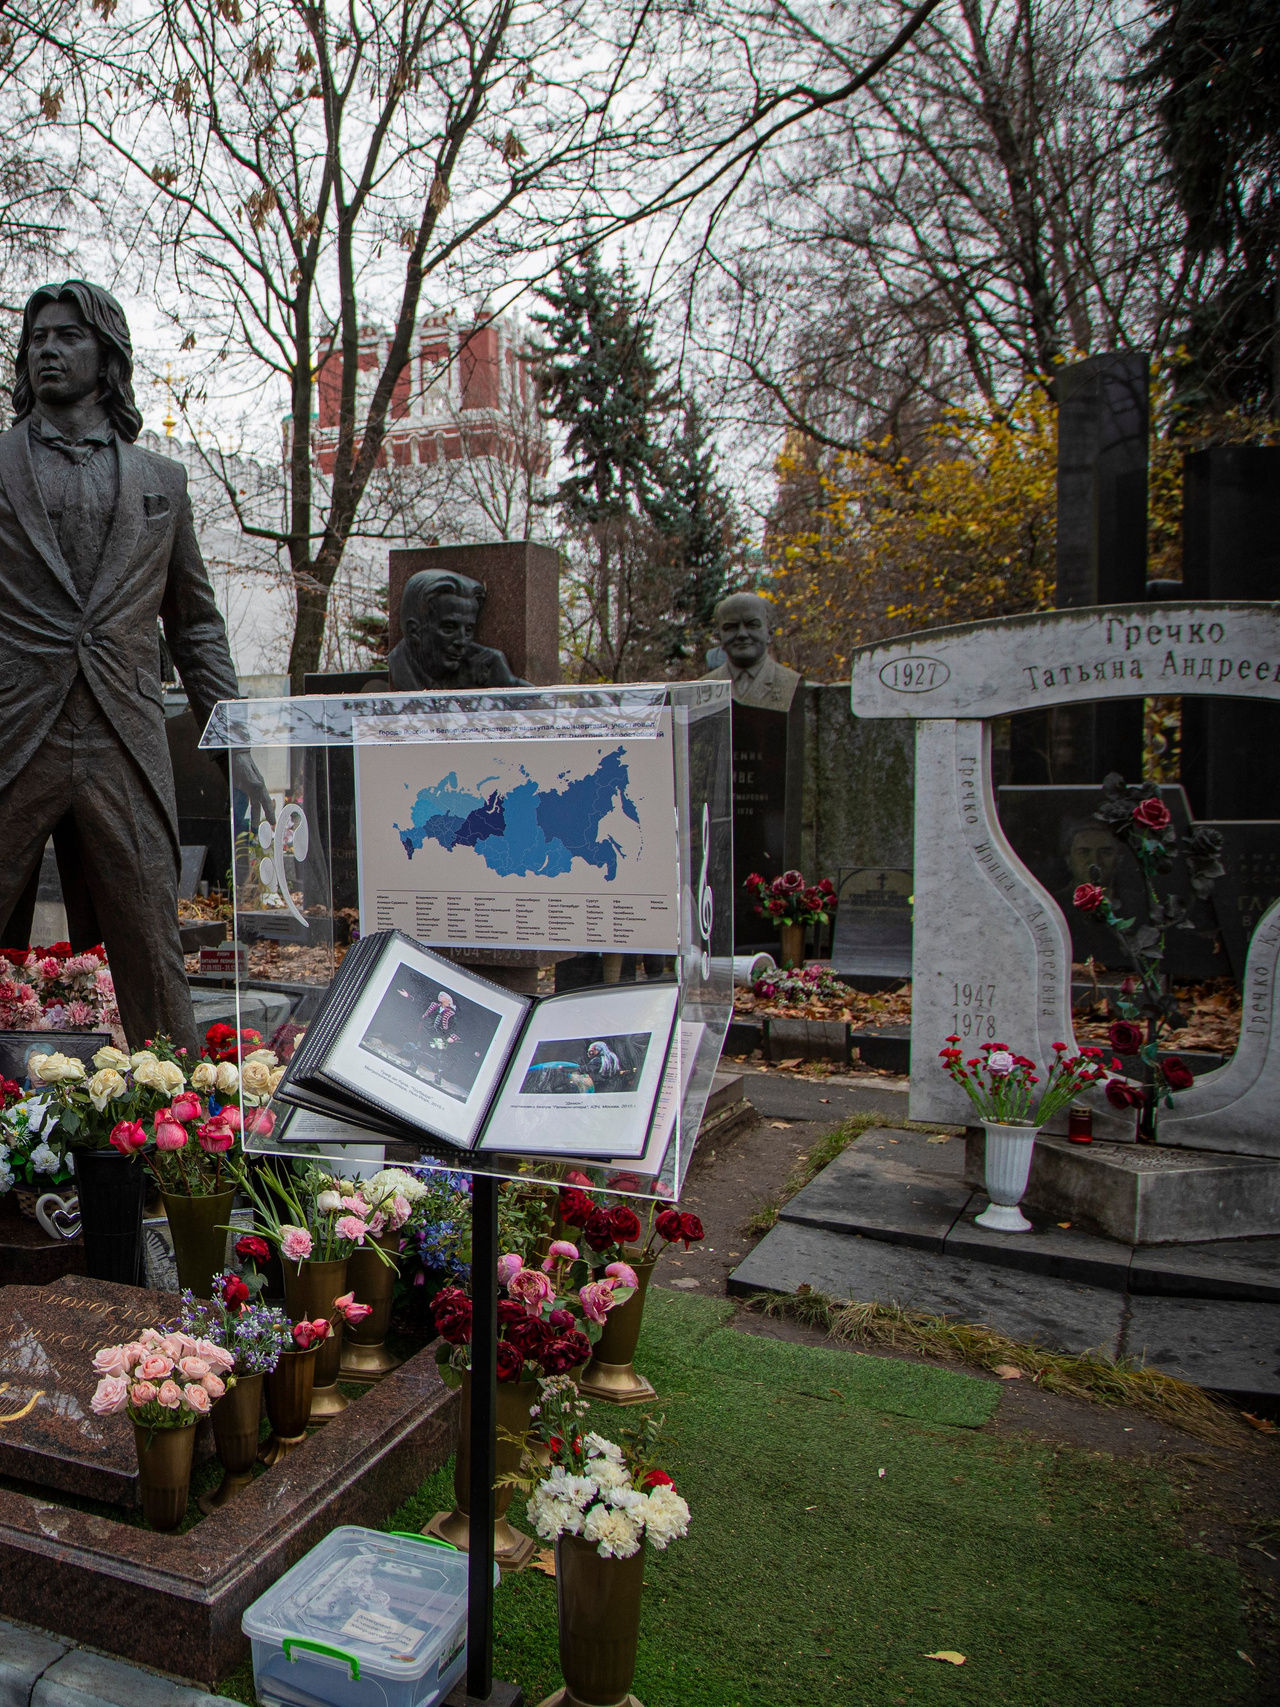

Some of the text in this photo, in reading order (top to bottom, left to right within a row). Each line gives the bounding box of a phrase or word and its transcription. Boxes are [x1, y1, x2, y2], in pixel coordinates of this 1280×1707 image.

[1106, 617, 1225, 650] Гречко
[892, 662, 938, 688] 1927
[1023, 660, 1143, 691] Татьяна
[958, 756, 1056, 1017] Гречко Ирина Андреевна
[952, 982, 997, 1008] 1947
[1246, 966, 1269, 1036] Гречко
[952, 1013, 997, 1039] 1978
[30, 1290, 177, 1328] ХВОРОСТОВС
